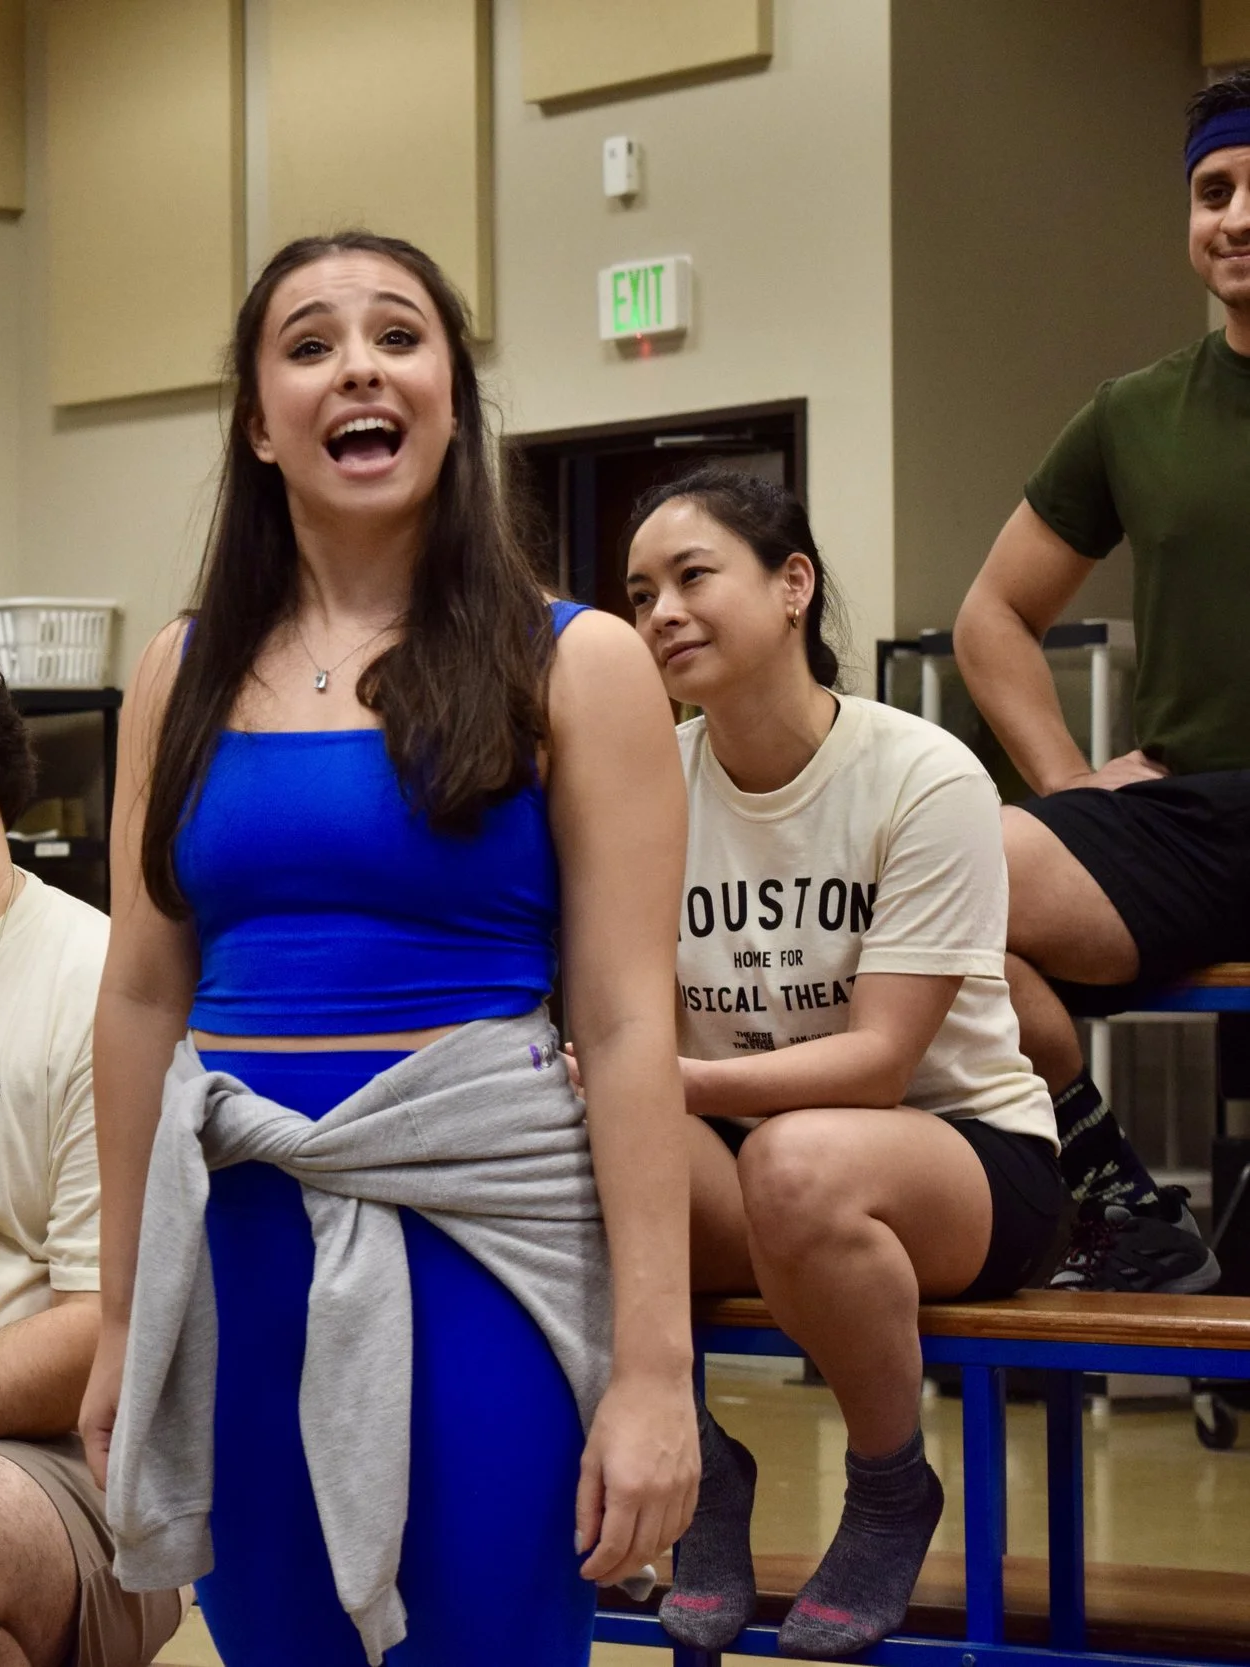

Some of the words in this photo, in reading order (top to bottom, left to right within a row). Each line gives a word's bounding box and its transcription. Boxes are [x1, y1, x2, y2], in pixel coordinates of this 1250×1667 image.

[612, 264, 664, 333] EXIT
[678, 877, 876, 942] OUSTON
[733, 951, 771, 968] HOME
[780, 949, 804, 967] FOR
[683, 985, 768, 1013] SICAL
